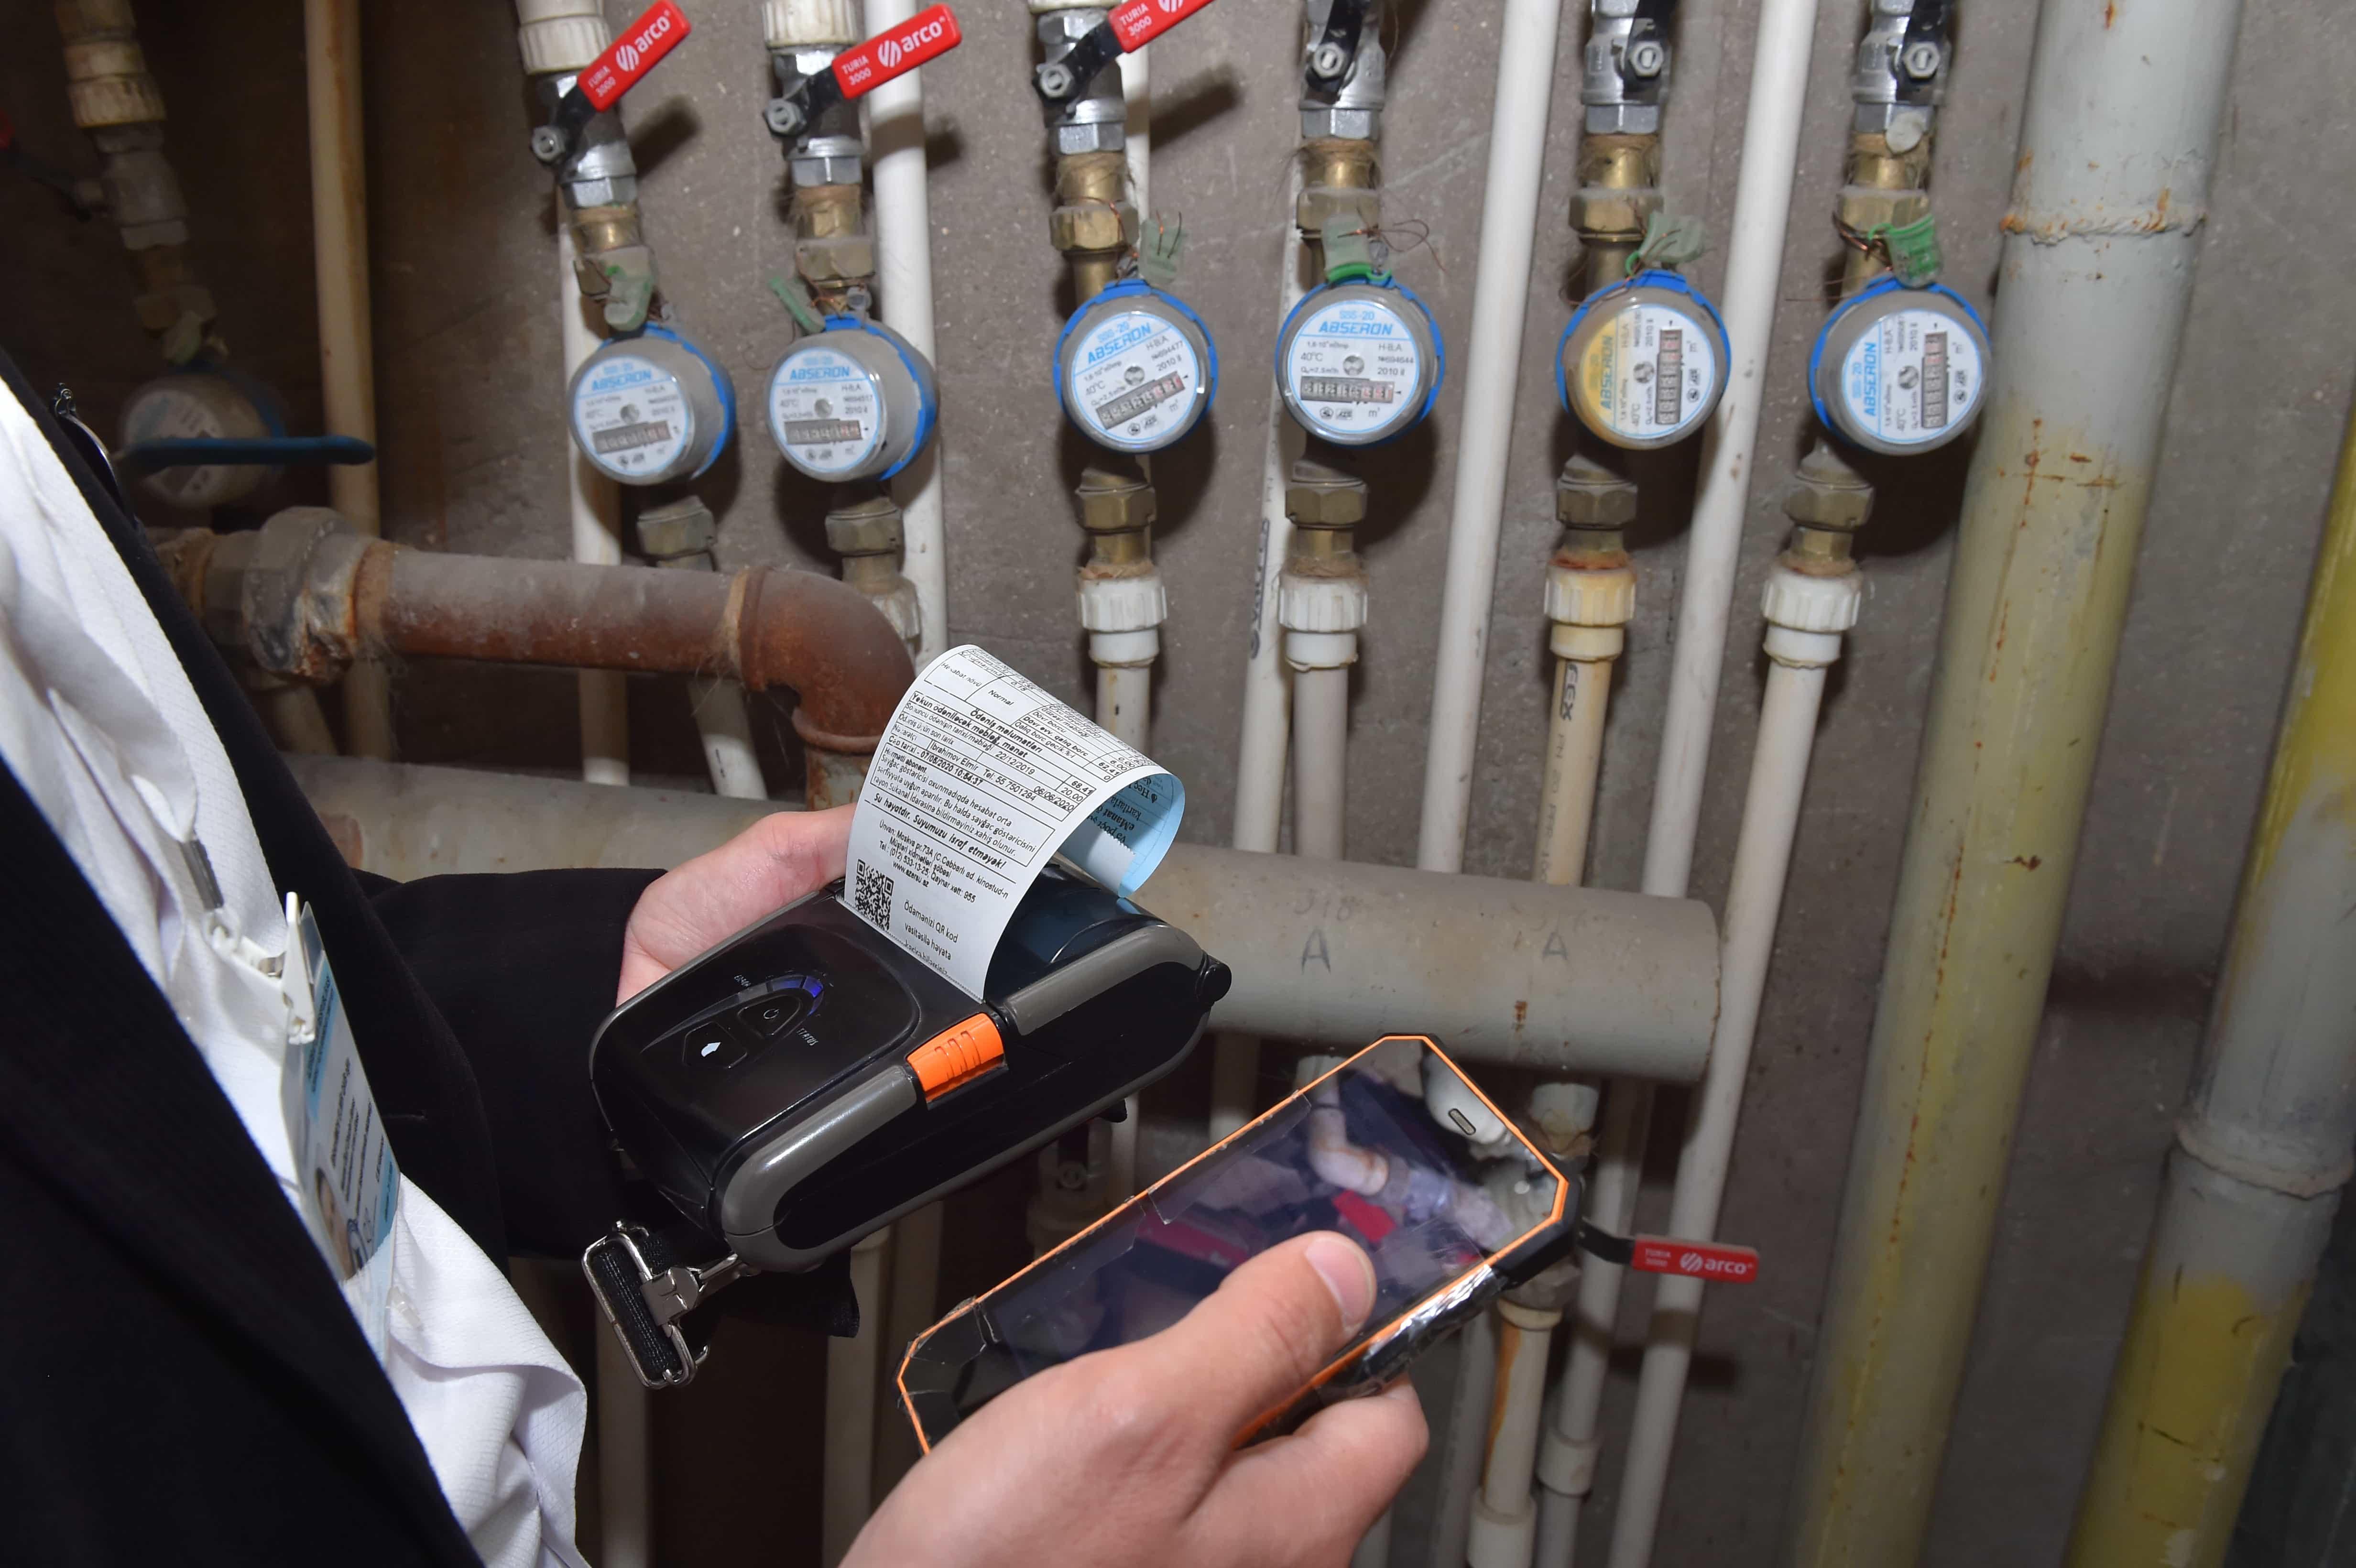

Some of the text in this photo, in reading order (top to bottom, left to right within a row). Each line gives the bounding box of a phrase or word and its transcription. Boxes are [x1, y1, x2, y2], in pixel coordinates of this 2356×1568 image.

[1119, 3, 1149, 25] TURIA
[634, 16, 671, 53] arco
[1128, 16, 1152, 36] 3000
[901, 22, 942, 53] arco
[841, 55, 869, 74] TURIA
[848, 67, 872, 86] 3000
[1319, 322, 1394, 335] ABSERON
[1087, 322, 1152, 364] ABSERON
[988, 690, 1014, 706] Normal
[912, 693, 933, 709] Yekun
[1002, 741, 1028, 758] manat
[1031, 730, 1046, 742] borc
[1047, 720, 1067, 733] borcu
[930, 730, 942, 740] son
[941, 733, 955, 745] tarix
[1072, 745, 1089, 757] borc
[995, 751, 1036, 775] 22/12/2019
[1099, 762, 1120, 775] 62,41
[960, 758, 979, 772] Elmir
[983, 769, 996, 780] Tel:
[995, 776, 1006, 785] 55
[1006, 781, 1037, 802] 7501294
[1071, 781, 1094, 795] 68,41
[1034, 785, 1075, 812] 06/06/2020
[1061, 787, 1083, 803] 20,00
[873, 775, 889, 788] rayon
[889, 782, 910, 800] Sukanal
[992, 838, 1016, 856] olunur.
[874, 793, 883, 803] Su
[913, 814, 948, 839] Suyumuzu
[944, 799, 953, 809] Bu
[953, 803, 971, 819] halda
[970, 799, 997, 819] hesabat
[997, 815, 1012, 827] orta
[1103, 808, 1135, 830] eManat
[896, 830, 916, 847] Moskva
[966, 870, 975, 881] ad.
[889, 848, 903, 862] (012)
[931, 872, 950, 888] Qaynar
[963, 891, 976, 903] 955
[936, 922, 946, 935] QR
[946, 928, 958, 943] kod
[931, 938, 951, 960] həyata
[1704, 1258, 1747, 1275] arco
